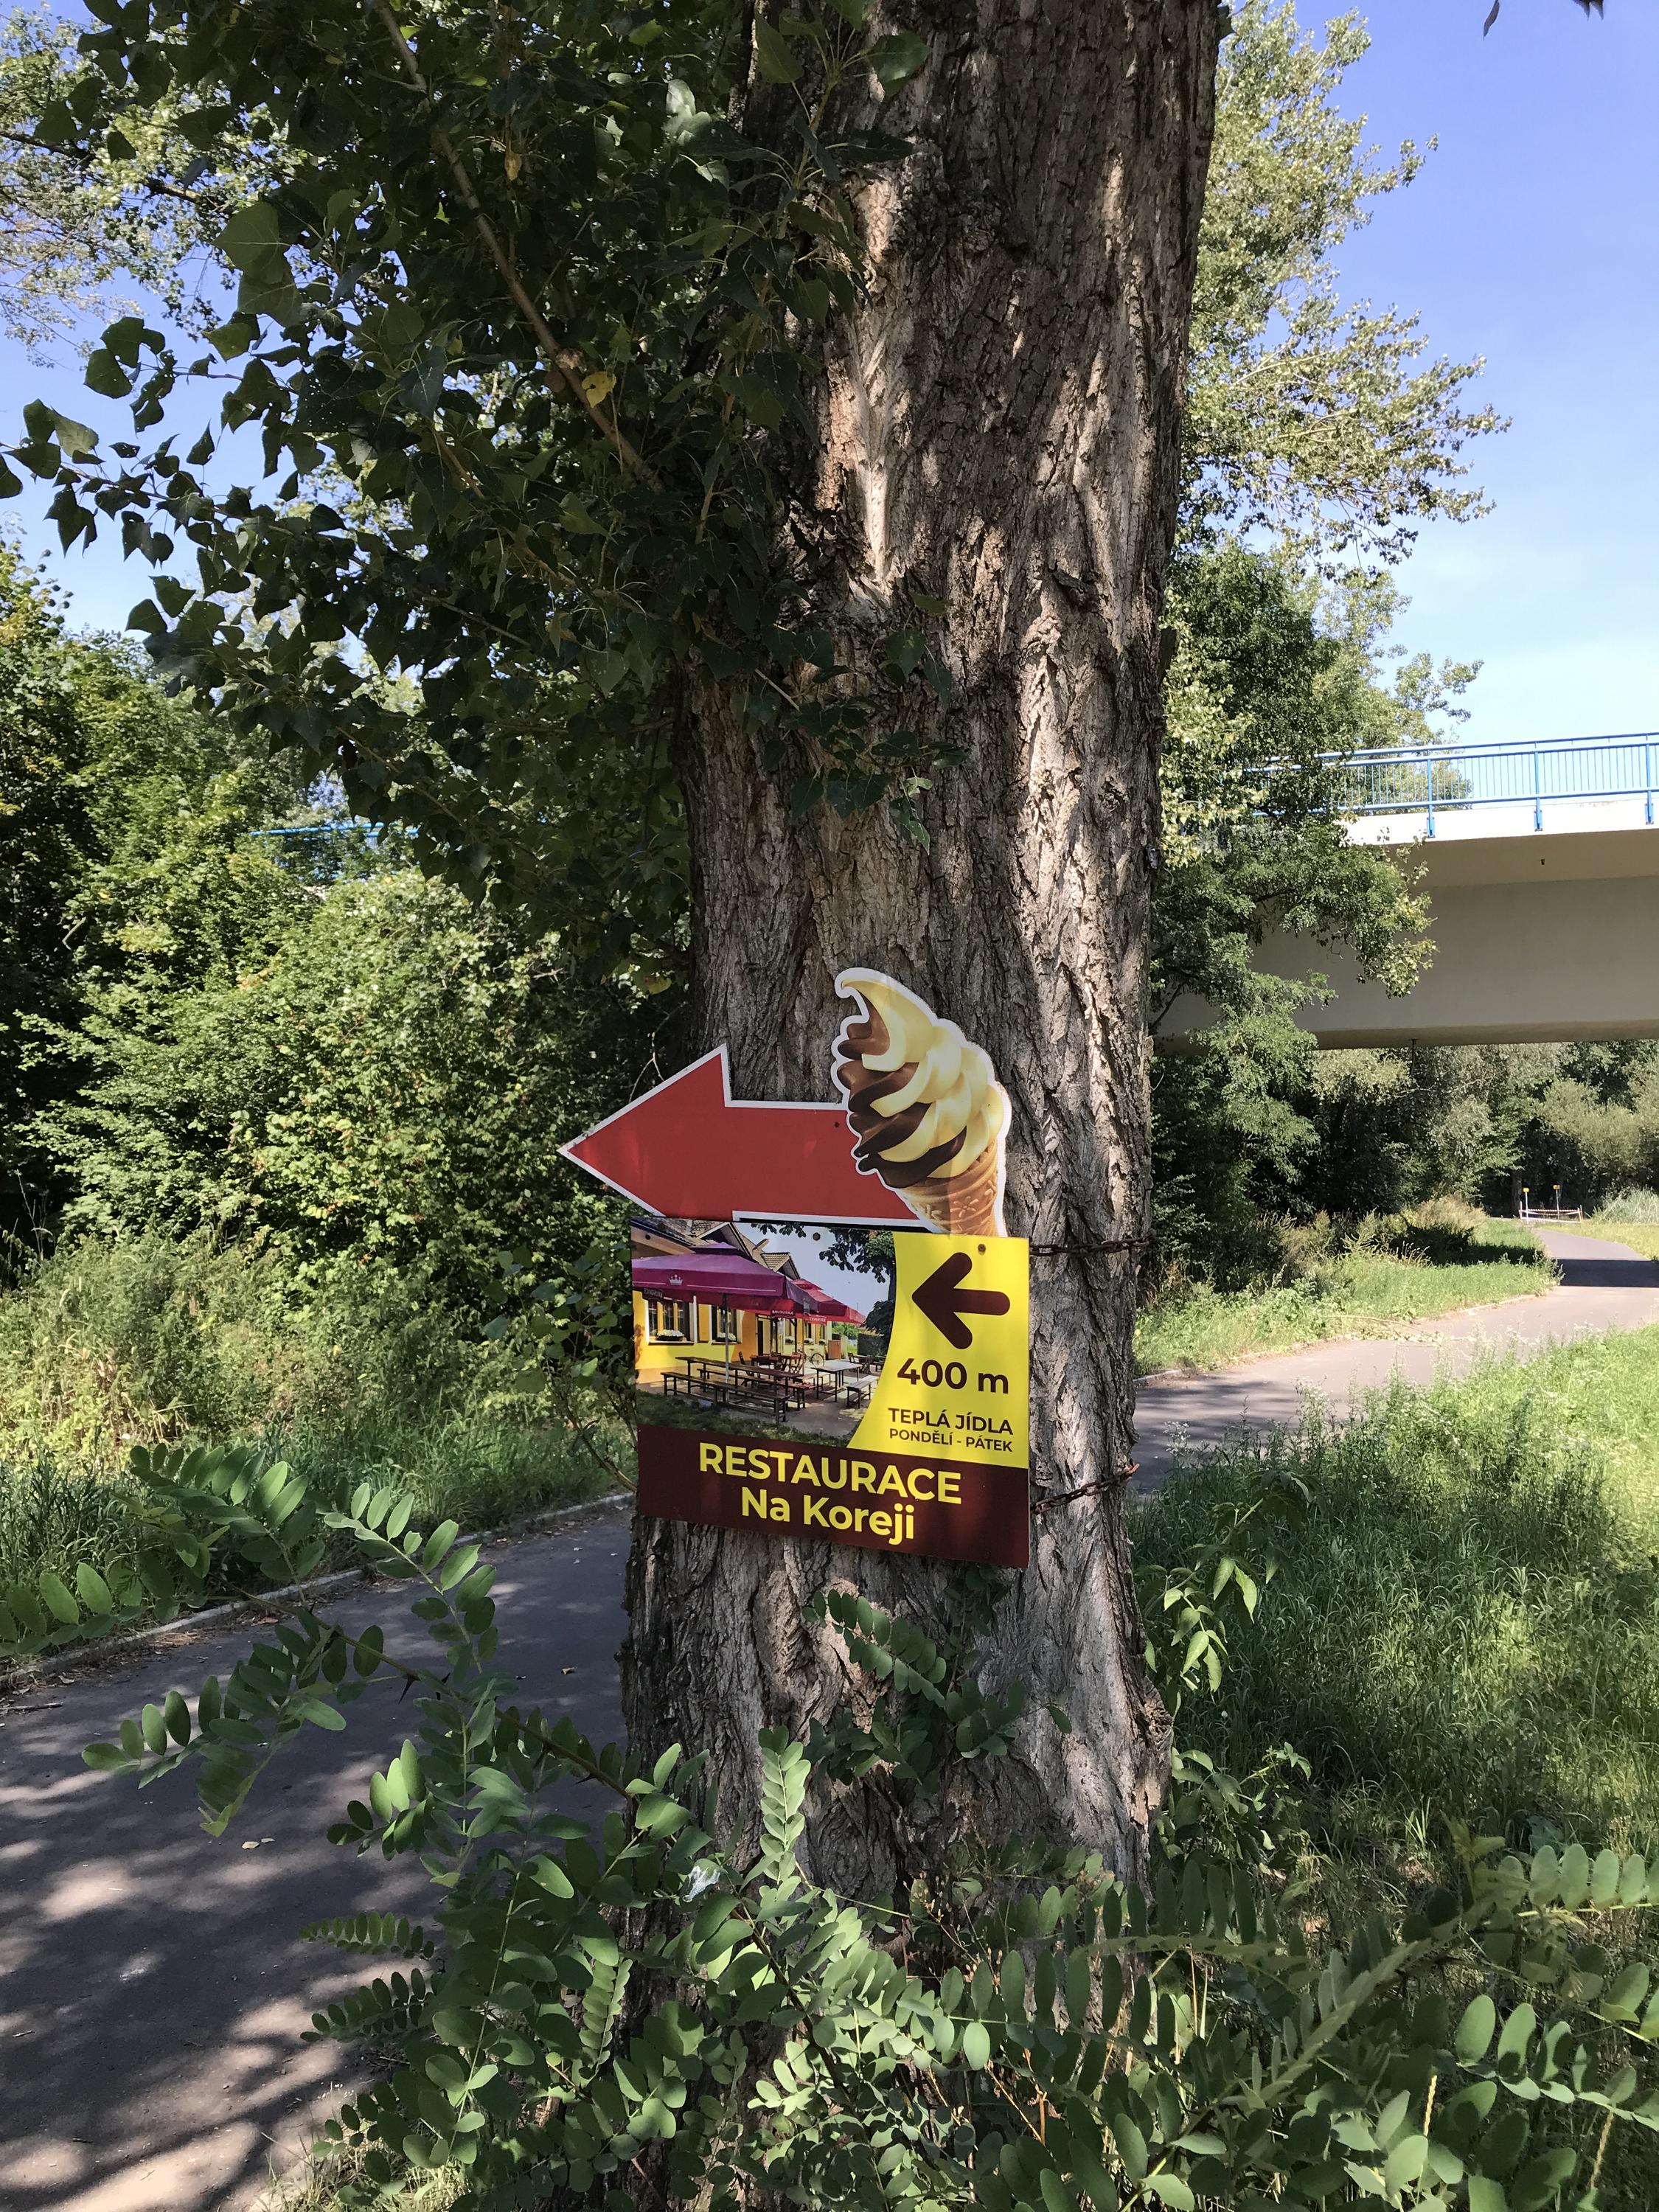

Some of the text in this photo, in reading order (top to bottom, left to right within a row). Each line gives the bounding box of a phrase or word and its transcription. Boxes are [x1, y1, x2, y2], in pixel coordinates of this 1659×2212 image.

[897, 1357, 1009, 1394] 400 m
[888, 1408, 1013, 1435] TEPLÁ JÍDLA
[889, 1428, 953, 1445] PONDĚLÍ
[966, 1435, 1012, 1452] PÁTEK
[700, 1442, 961, 1504] RESTAURACE
[742, 1486, 914, 1545] Na Koreji
